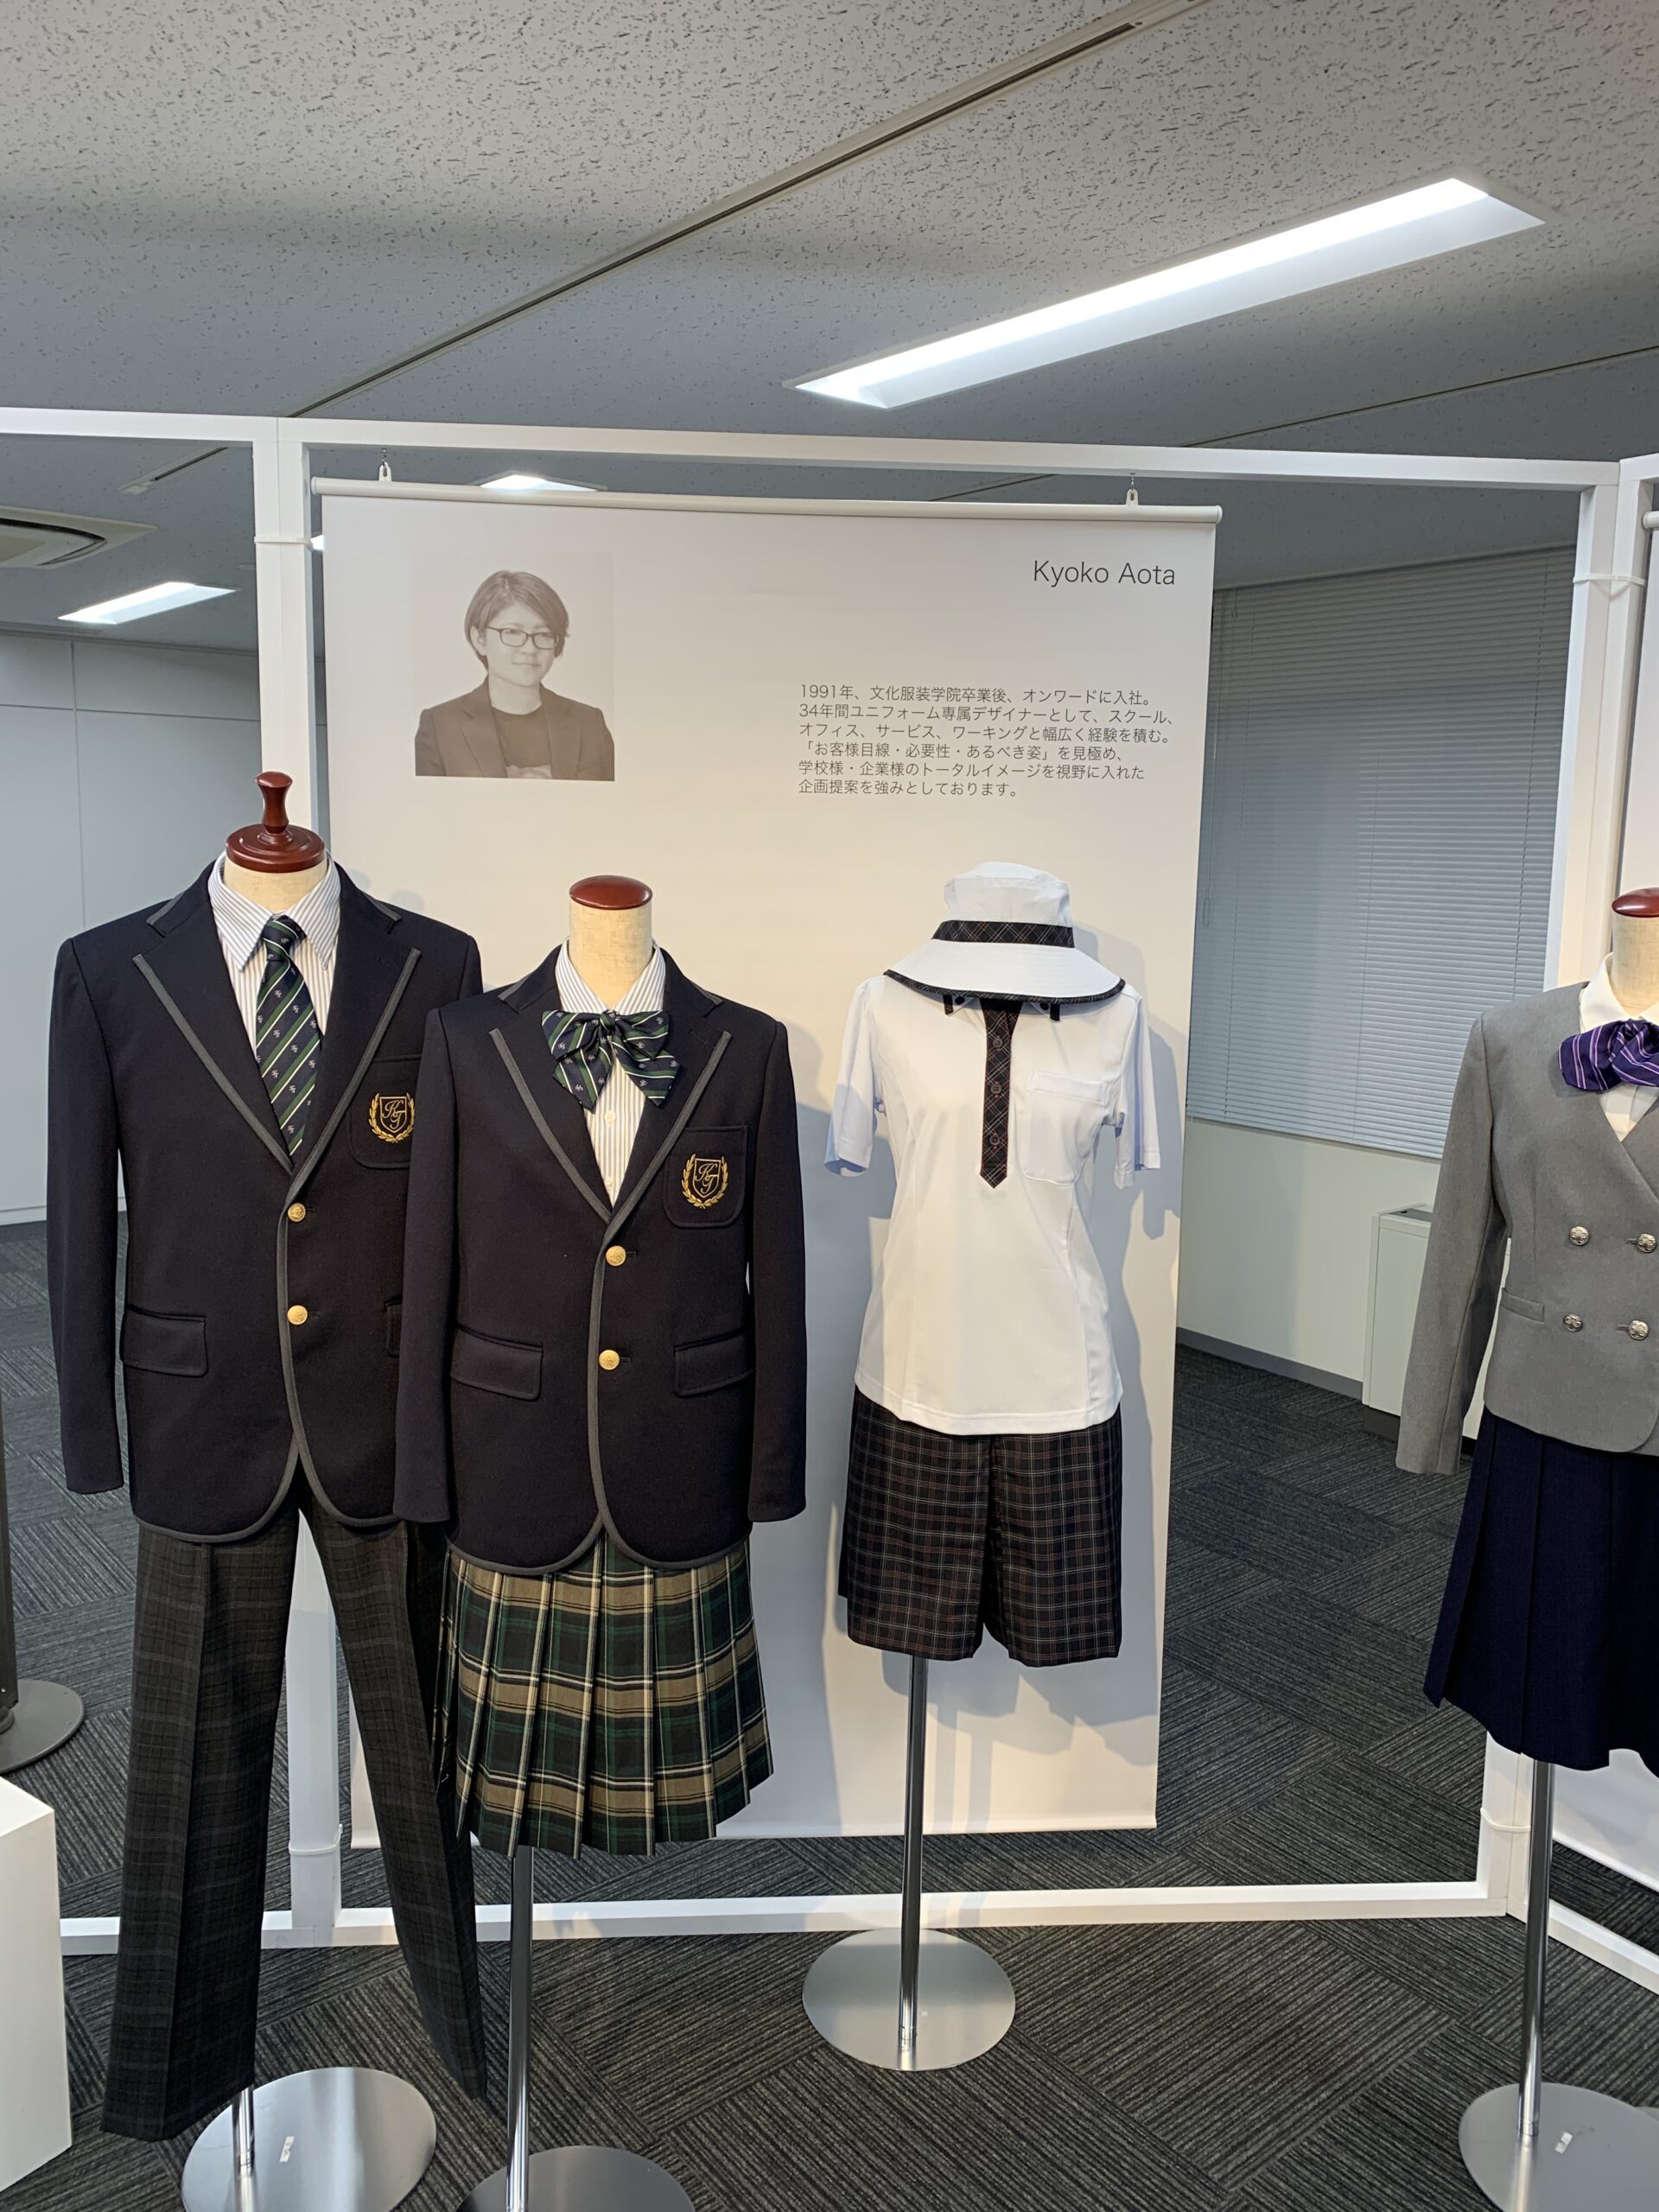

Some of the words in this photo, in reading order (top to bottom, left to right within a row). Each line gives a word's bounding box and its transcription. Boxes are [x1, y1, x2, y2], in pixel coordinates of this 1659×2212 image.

[1033, 560, 1109, 588] Kyoko
[1118, 563, 1175, 585] Aota
[801, 684, 1148, 706] 1991年、文化服装学院卒業後、オンワードに入社。
[799, 703, 1173, 724] 34年間ユニフォーム専属デザイナーとして、スクール、
[799, 722, 1168, 744] オフィス、サービス、ワーキングと幅広く経験を積む。
[808, 741, 1122, 760] 「お客様目線・必要性・あるべき姿」を見極め、
[798, 760, 1145, 779] 学校様・企業様のトータルイメージを視野に入れた
[798, 779, 1016, 797] 企画提案を強みとしております。
